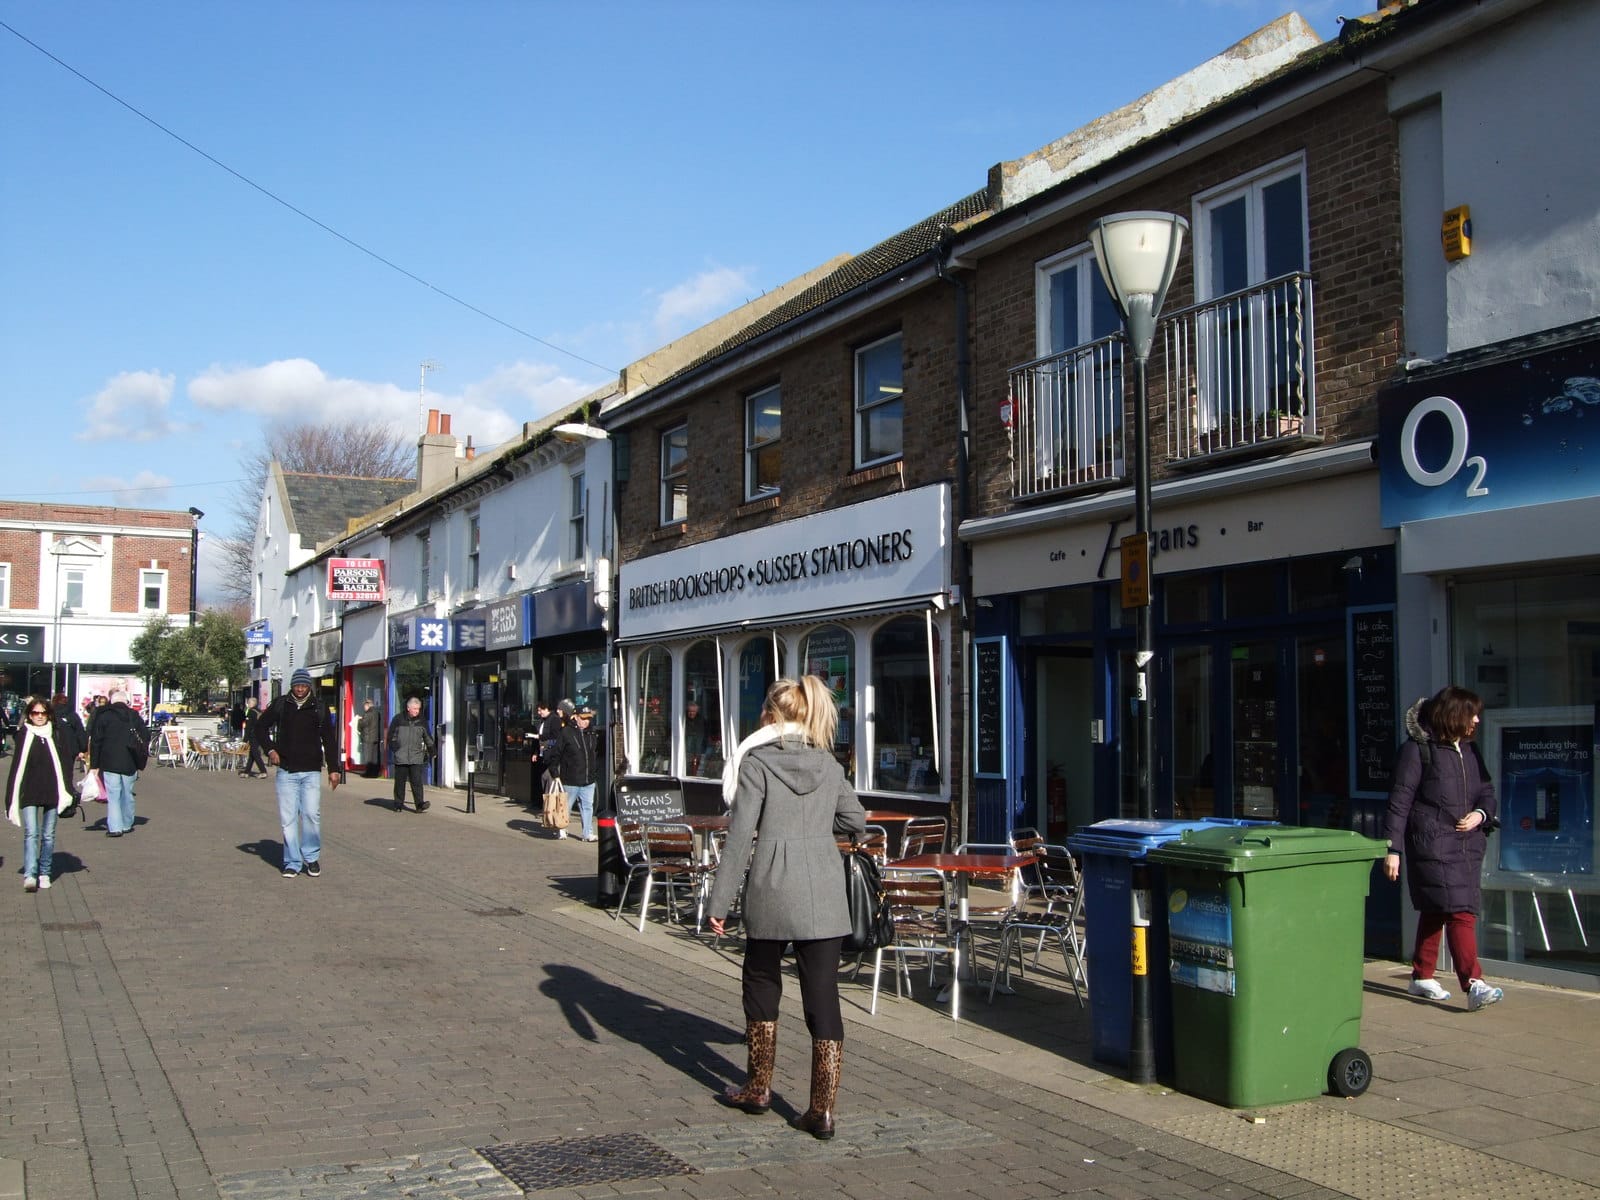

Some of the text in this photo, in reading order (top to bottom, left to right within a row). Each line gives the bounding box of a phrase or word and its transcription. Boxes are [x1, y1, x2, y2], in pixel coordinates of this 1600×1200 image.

[1400, 396, 1489, 498] O2
[1247, 520, 1264, 533] Bar
[1049, 550, 1066, 562] Cafe
[334, 568, 379, 577] PARSONS
[629, 528, 913, 610] BRITISH BOOKSHOPS SUSSEX STATIONERS
[338, 576, 369, 585] SON &
[343, 584, 378, 592] BASLEY
[1519, 740, 1578, 751] Introducing the
[1510, 752, 1528, 760] New
